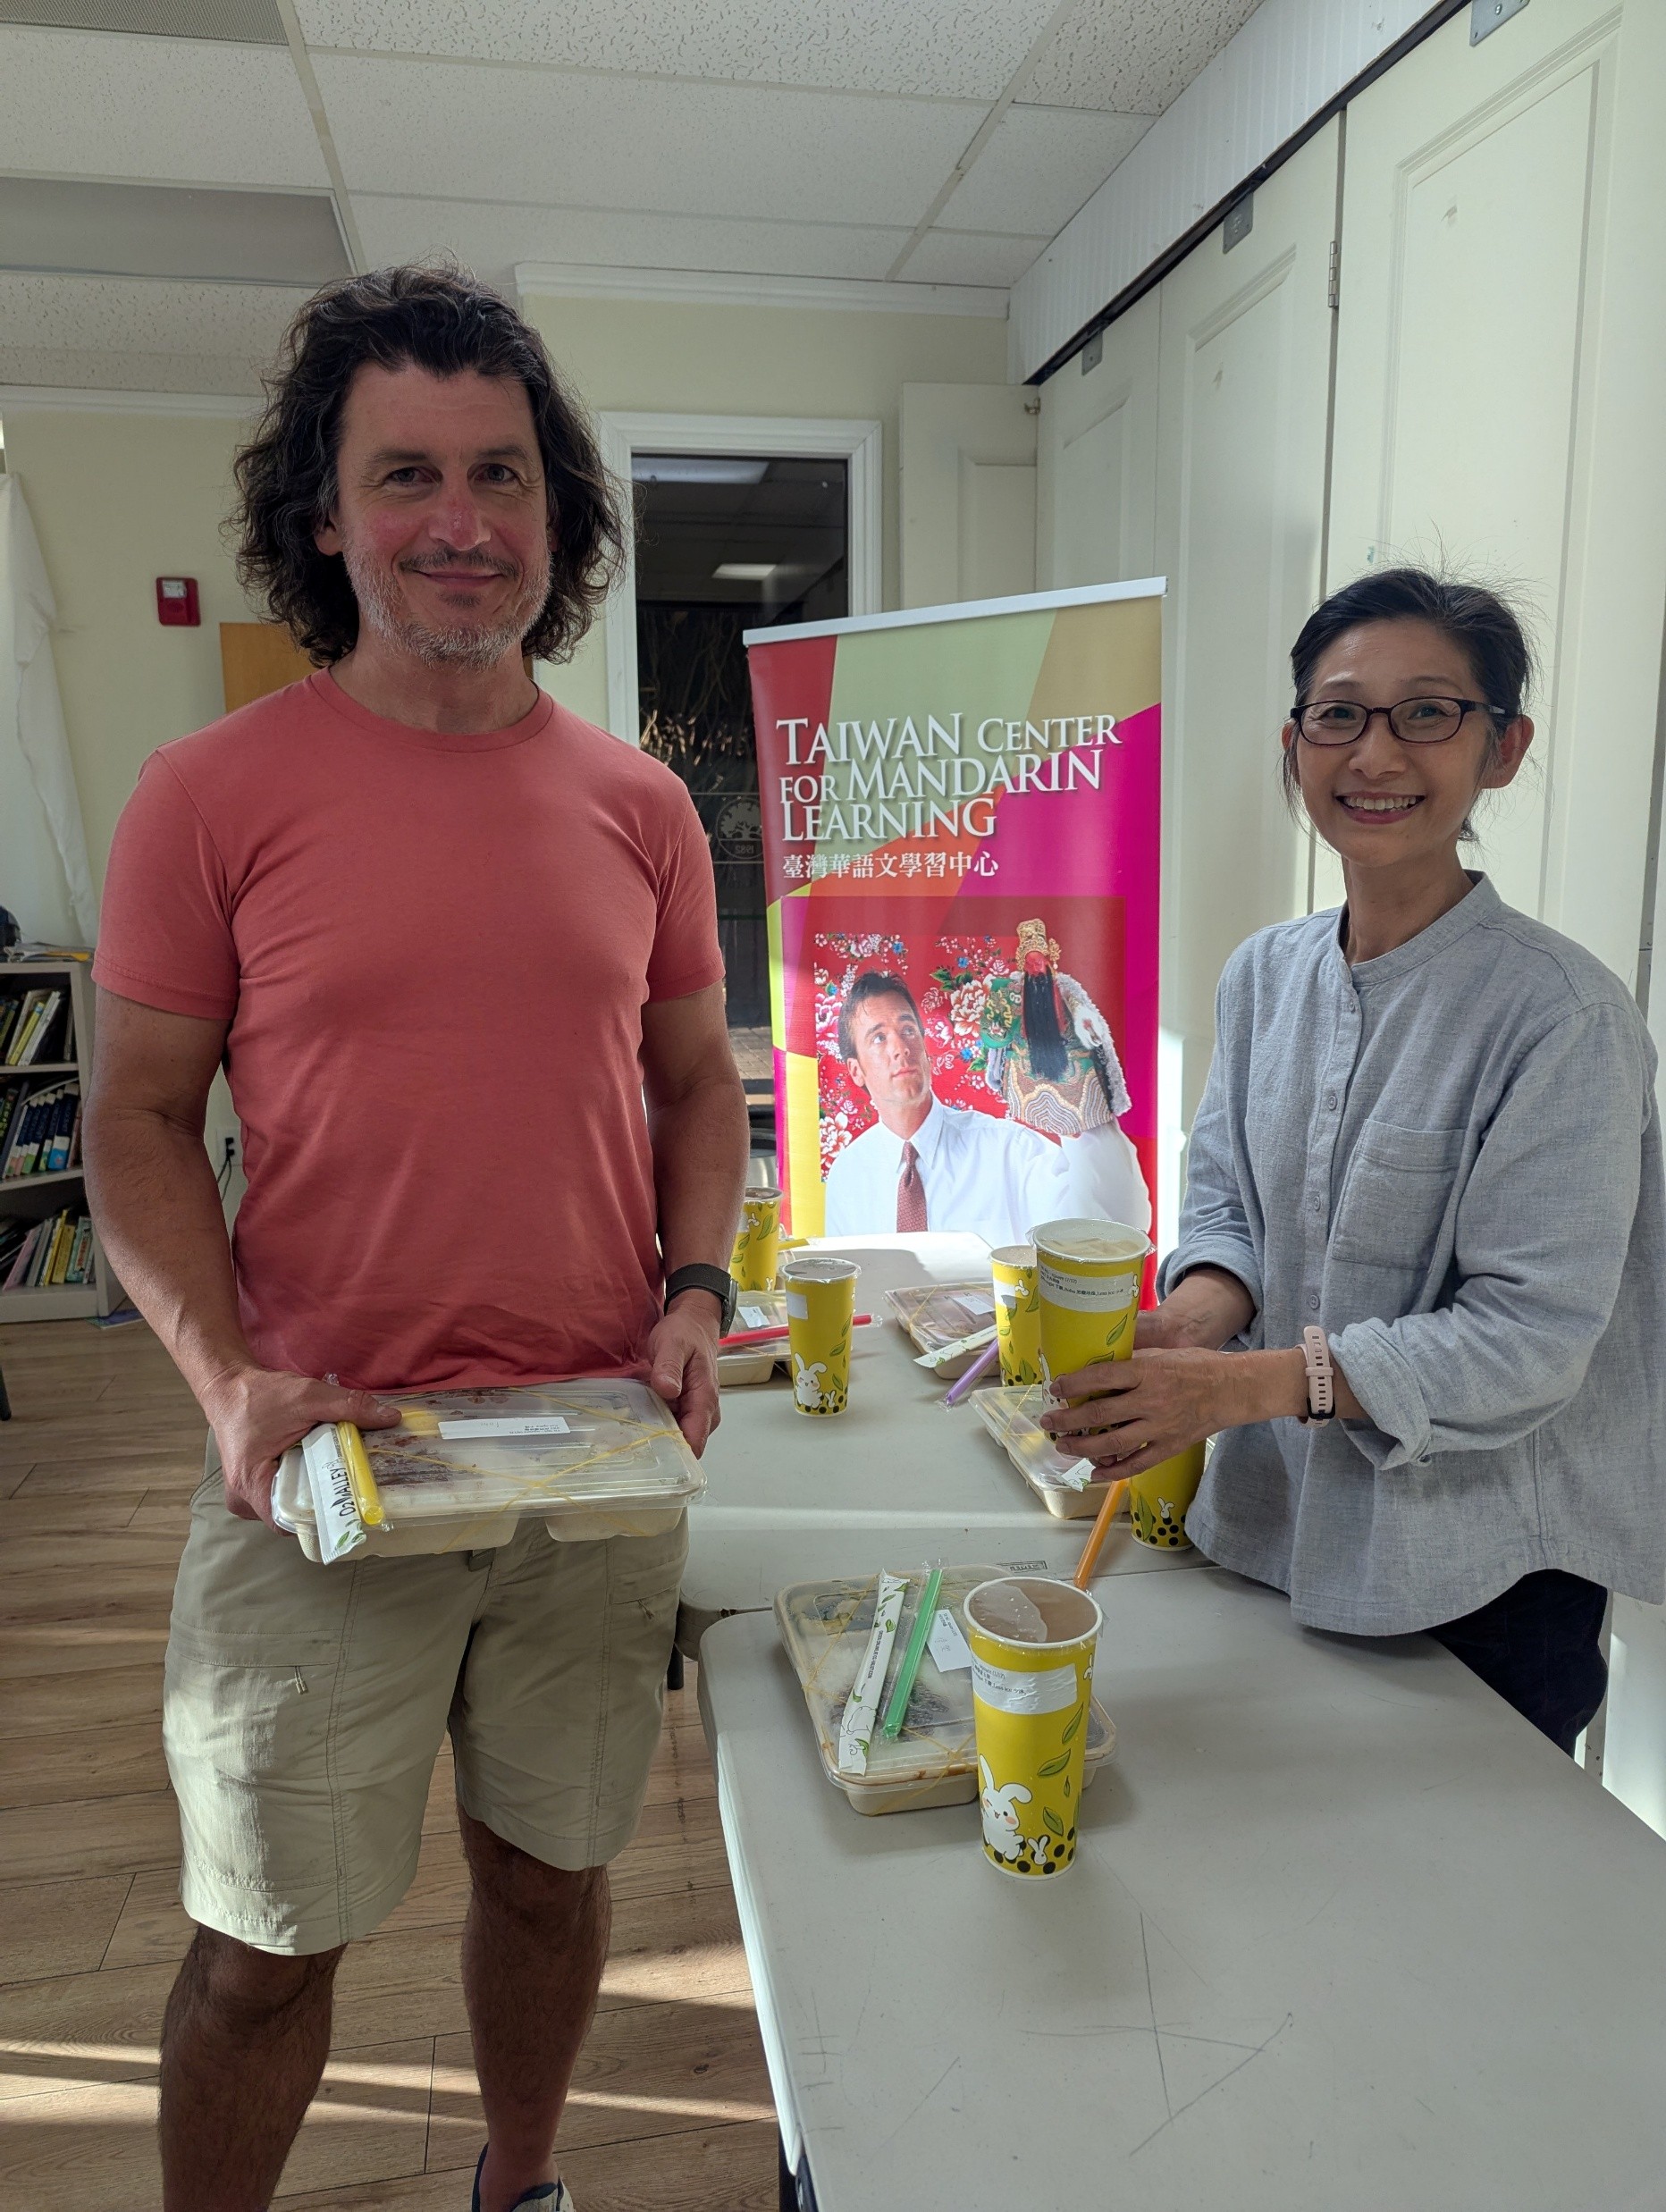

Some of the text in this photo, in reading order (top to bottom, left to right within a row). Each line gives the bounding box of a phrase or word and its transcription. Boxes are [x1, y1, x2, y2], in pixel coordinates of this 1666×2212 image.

[776, 712, 1123, 765] TAIWAN CENTER
[778, 749, 1103, 803] FOR MANDARIN
[781, 798, 997, 842] LEARNING
[782, 851, 999, 879] 臺灣華語文學習中心
